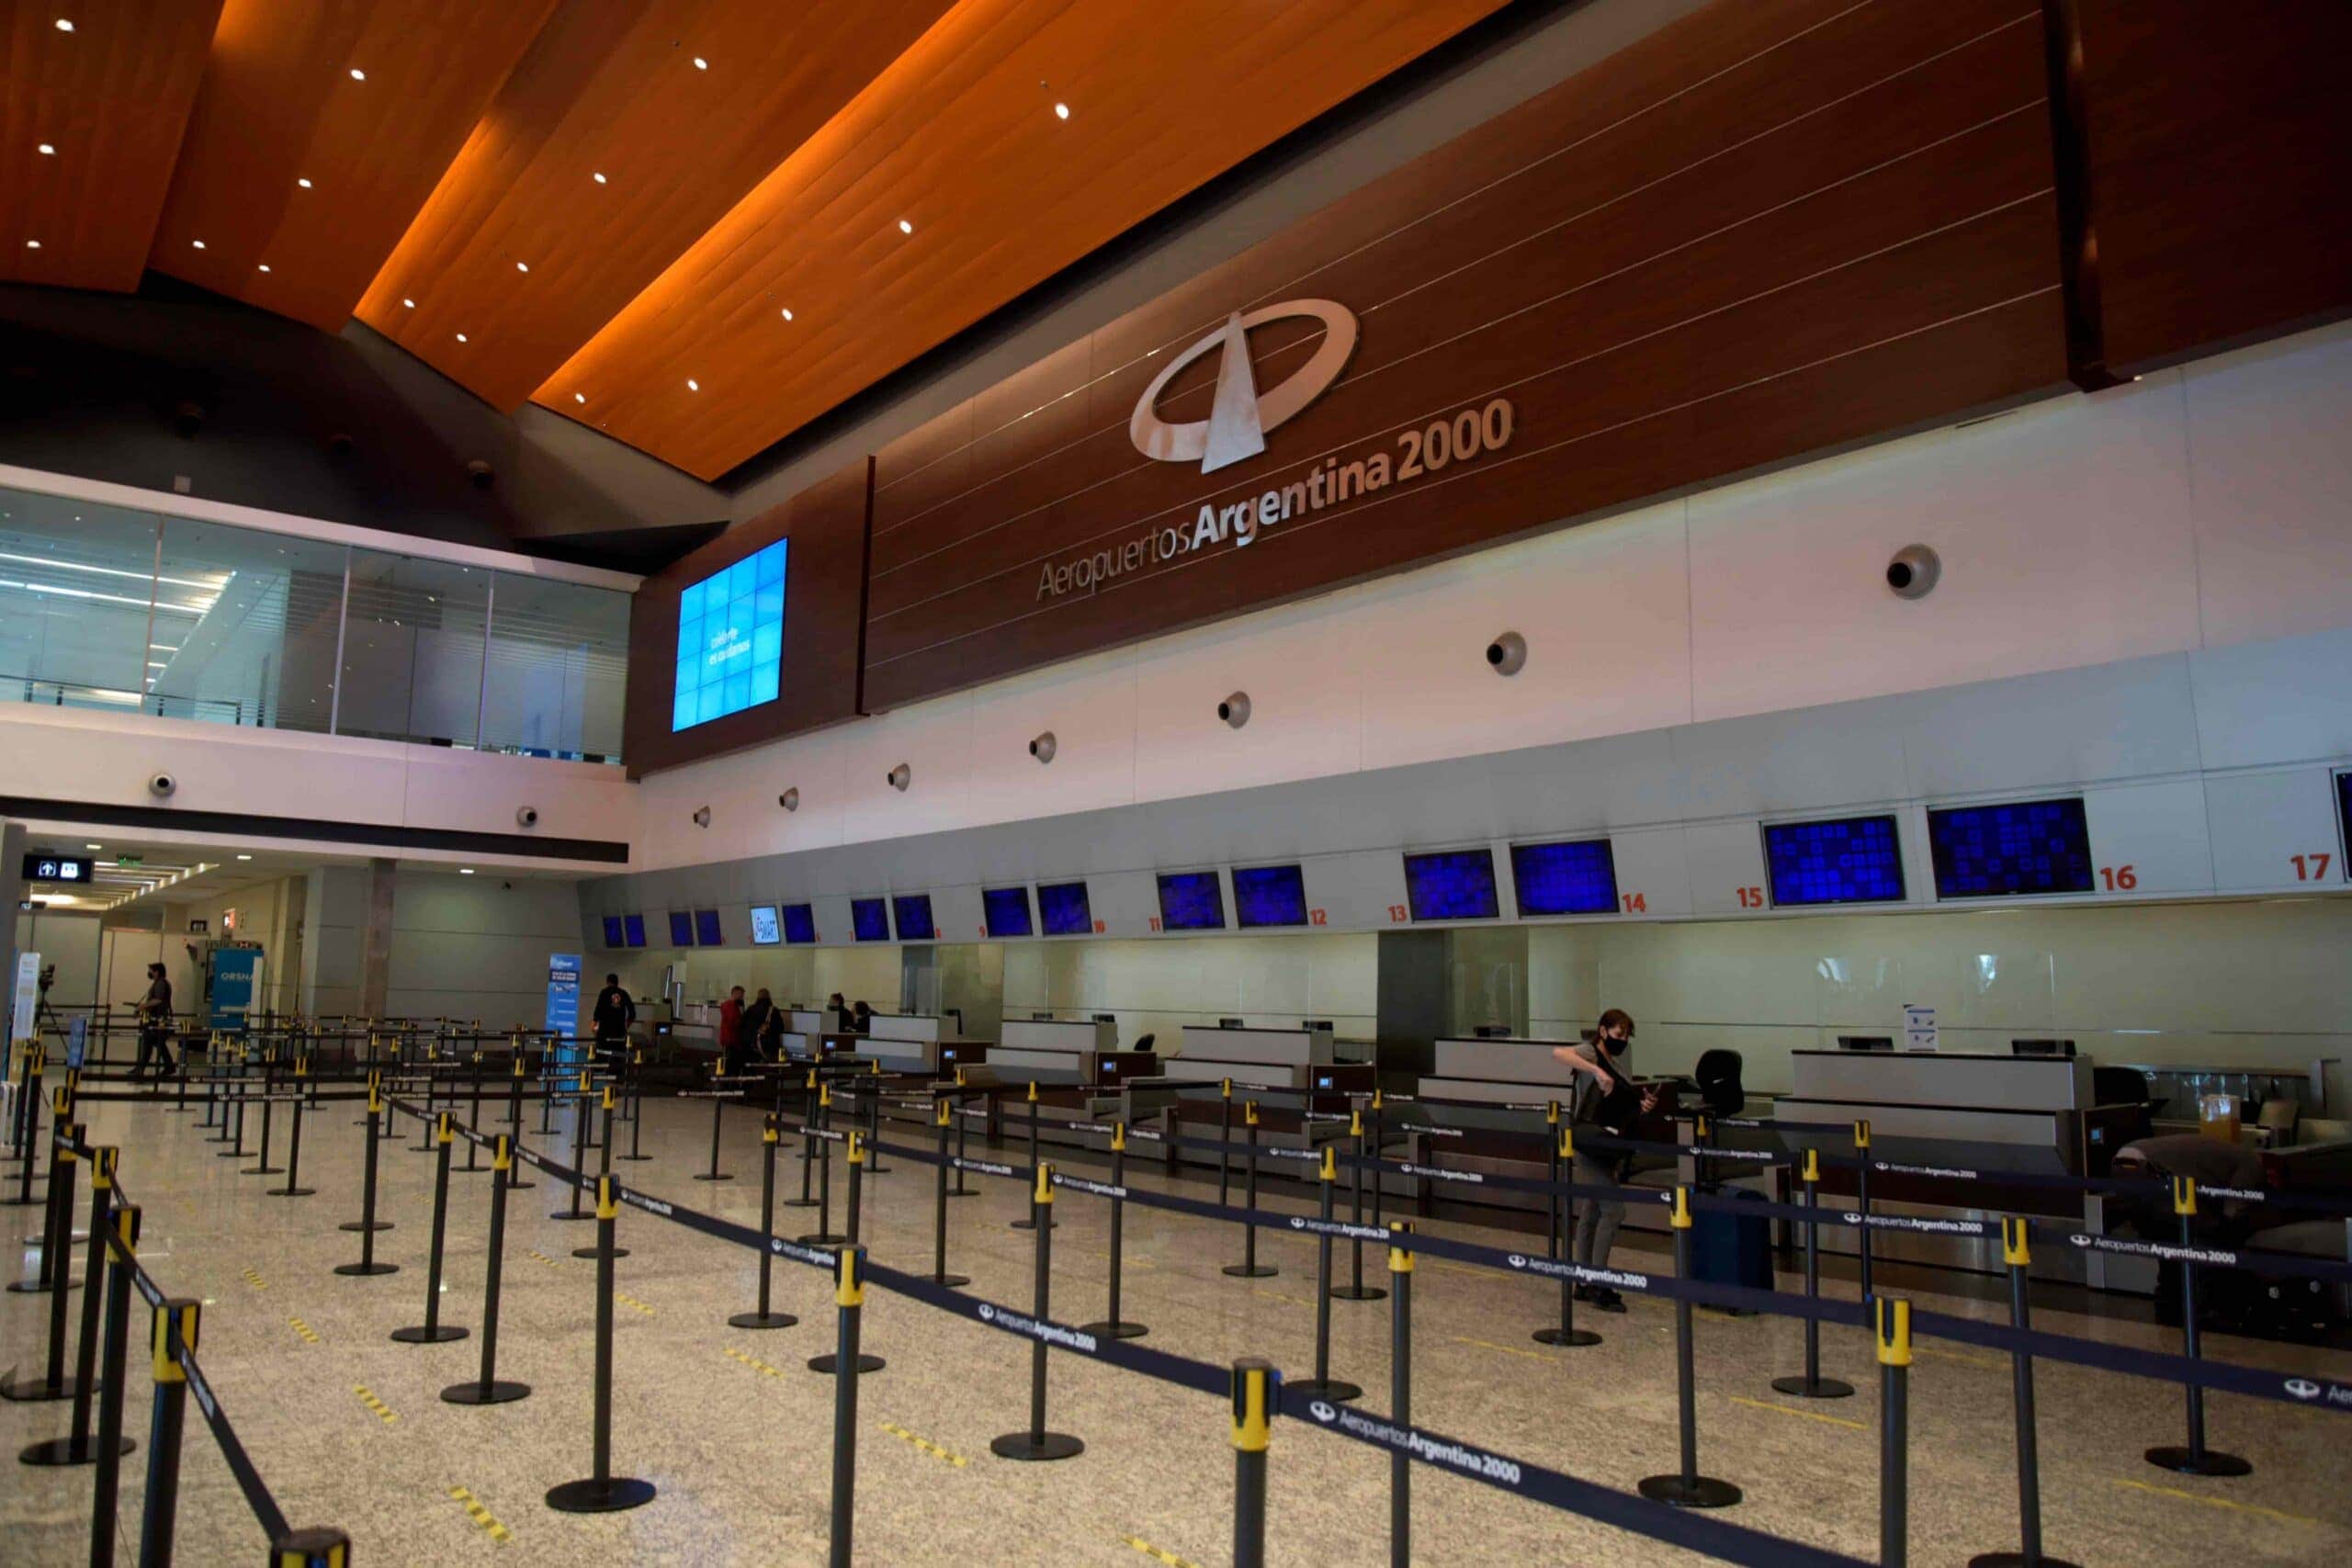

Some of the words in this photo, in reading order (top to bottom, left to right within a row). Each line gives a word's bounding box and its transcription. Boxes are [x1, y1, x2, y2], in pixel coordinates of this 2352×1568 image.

[1396, 398, 1515, 482] 2000
[2099, 864, 2137, 892] 16
[2290, 852, 2331, 882] 17
[1623, 892, 1646, 914] 14
[1736, 886, 1763, 908] 15
[1149, 917, 1160, 931] 11
[1310, 908, 1328, 927] 12
[1388, 904, 1407, 923] 13
[1911, 1217, 1958, 1233] Argentina
[1960, 1221, 1984, 1234] 2000
[2150, 1243, 2208, 1261] Argentina
[2209, 1250, 2237, 1265] 2000
[1408, 1430, 1481, 1472] Argentina
[1483, 1455, 1521, 1485] 2000
